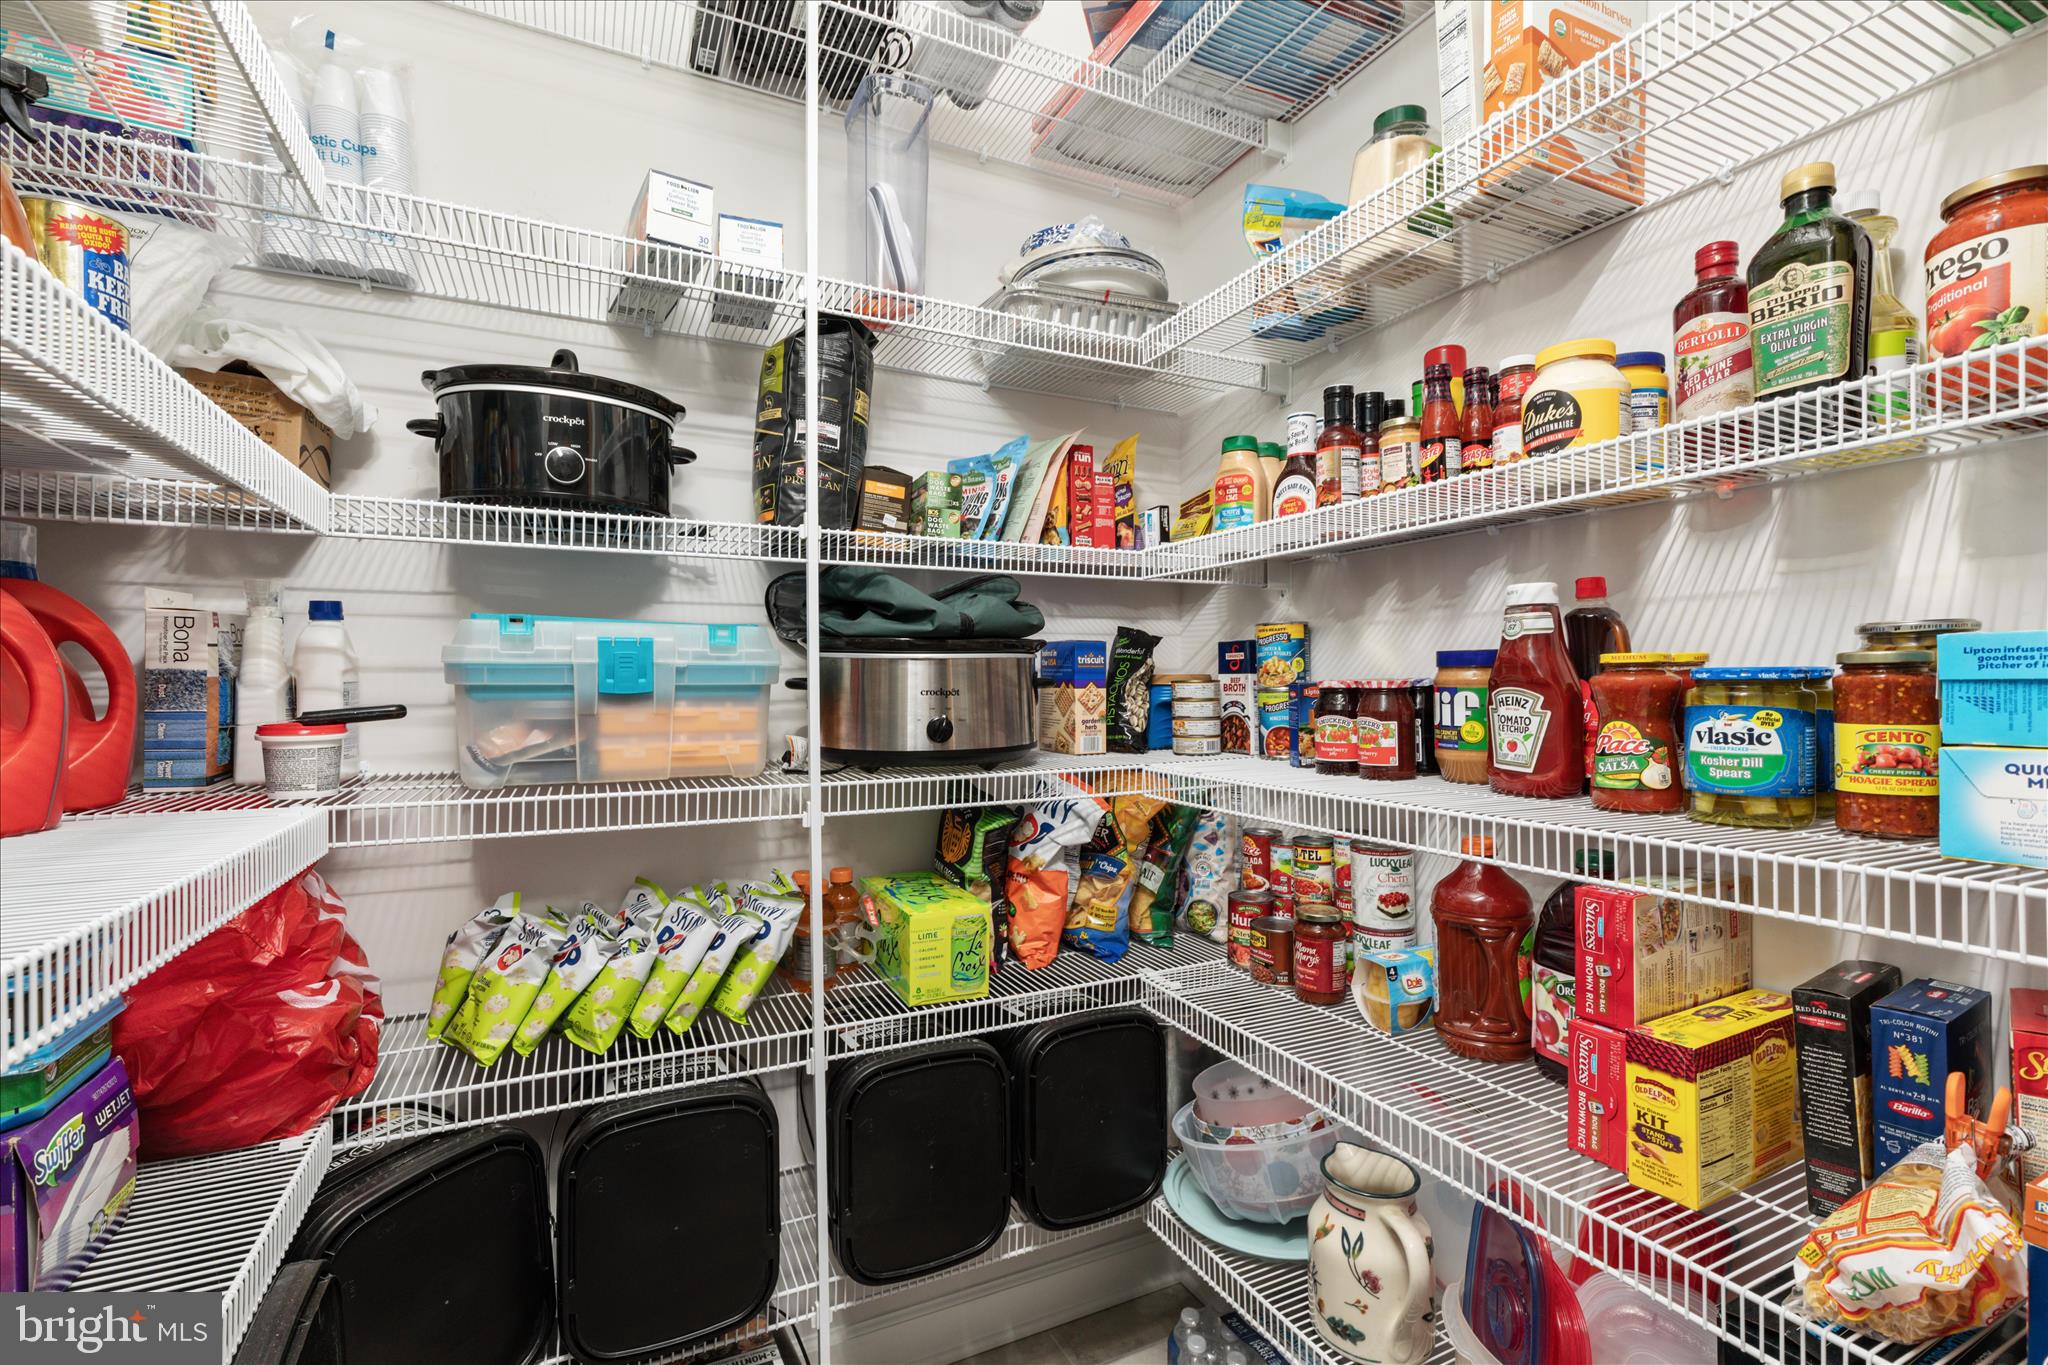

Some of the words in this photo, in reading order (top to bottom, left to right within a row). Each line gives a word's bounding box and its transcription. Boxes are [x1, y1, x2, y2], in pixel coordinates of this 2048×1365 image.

[1600, 6, 1632, 27] harvest
[341, 139, 377, 156] Cups
[59, 222, 98, 233] REMOVES
[699, 236, 709, 244] 30
[1766, 284, 1820, 306] FILIPPO
[1751, 284, 1843, 324] BERIO
[1761, 327, 1791, 344] EXTRA
[1793, 317, 1828, 335] VIRGIN
[1678, 326, 1741, 353] BERTOLLI
[1770, 335, 1798, 353] OLIVE
[1800, 332, 1817, 345] OIL
[1684, 374, 1700, 391] RED
[1704, 356, 1733, 377] WINE
[1686, 368, 1731, 397] VINEGAR
[543, 414, 585, 427] crockpot
[1524, 401, 1576, 432] Duke's
[1535, 419, 1574, 436] MAYONNAISE
[1074, 452, 1091, 463] fun
[819, 480, 842, 492] LAN
[1287, 483, 1298, 491] BABY
[173, 616, 195, 663] Bona
[1963, 647, 2001, 655] Lipton
[1977, 654, 2036, 663] goodness
[1077, 655, 1105, 665] triscuit
[1977, 662, 2022, 671] pitcher
[2025, 661, 2039, 669] of
[920, 688, 960, 698] crockpot
[1106, 662, 1130, 725] PISTACHIOS
[1223, 683, 1246, 692] BROTH
[1265, 702, 1289, 712] PROGRES
[1499, 696, 1530, 709] HEINZ
[1081, 718, 1099, 726] garden
[1497, 715, 1532, 726] TOMATO
[1498, 725, 1530, 734] KETCHUP
[1696, 727, 1772, 746] vlasic
[1596, 734, 1650, 755] Pace
[1864, 731, 1925, 744] CENTO
[1598, 760, 1639, 772] SALSA
[1701, 755, 1739, 767] Kosher
[1743, 757, 1763, 768] Dill
[1710, 768, 1751, 779] Spears
[1850, 776, 1892, 786] HOAGIE
[1896, 777, 1937, 786] SPREAD
[1099, 860, 1118, 873] Chips
[1585, 899, 1599, 950] Success
[917, 932, 939, 940] LIME
[966, 930, 983, 956] La
[1370, 939, 1391, 949] LEAF
[952, 951, 987, 975] Croix
[1585, 955, 1593, 990] BROWN
[1406, 978, 1423, 987] Dole
[1585, 993, 1594, 1014] RICE
[1795, 1004, 1811, 1013] RED
[1812, 1007, 1848, 1020] LOBSTER
[1879, 1019, 1914, 1028] TRI-COLOR
[1916, 1024, 1940, 1038] ROTINI
[1579, 1034, 1593, 1086] Success
[1700, 1068, 1719, 1081] Nutrition
[1719, 1065, 1732, 1075] Facts
[1634, 1085, 1647, 1095] OLD
[1912, 1091, 1926, 1101] 7-8
[95, 1088, 131, 1126] WETJET
[1578, 1090, 1587, 1121] BROWN
[1633, 1102, 1645, 1111] Taco
[1647, 1108, 1667, 1119] Dinner
[1700, 1101, 1718, 1112] Calories
[1893, 1102, 1930, 1118] Barilla
[1637, 1110, 1669, 1130] KIT
[1577, 1124, 1586, 1149] RICE
[1641, 1127, 1666, 1141] STAND
[1651, 1138, 1675, 1150] STUFF
[35, 1125, 85, 1185] Swiffer
